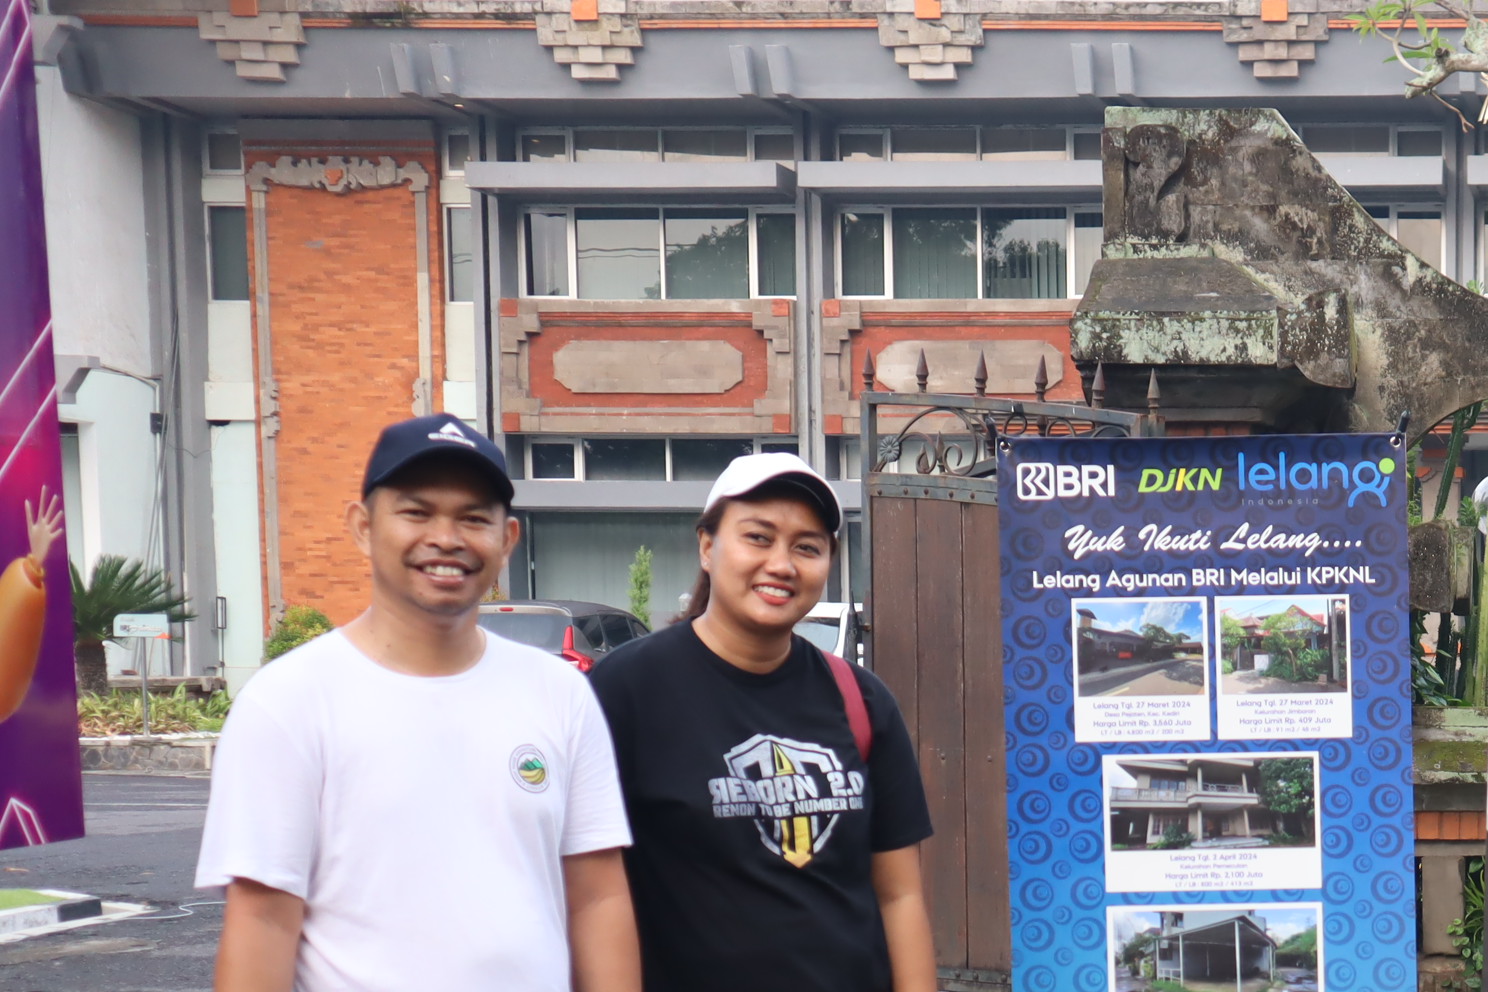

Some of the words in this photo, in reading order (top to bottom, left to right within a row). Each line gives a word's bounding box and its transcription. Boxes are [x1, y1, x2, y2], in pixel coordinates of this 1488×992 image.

[1057, 464, 1114, 496] BRI
[1138, 468, 1222, 493] DJKN
[1238, 452, 1395, 507] lelang
[1065, 525, 1126, 559] Yuk
[1139, 524, 1211, 551] Ikuti
[1032, 570, 1100, 591] Lelang
[1106, 570, 1186, 591] Agunan
[1192, 569, 1224, 586] BRI
[1231, 568, 1300, 585] Melalui
[1306, 566, 1375, 585] KPKNL
[827, 771, 864, 796] 2.0
[759, 804, 773, 816] TO
[774, 804, 790, 817] BE
[794, 797, 848, 814] NUMBER
